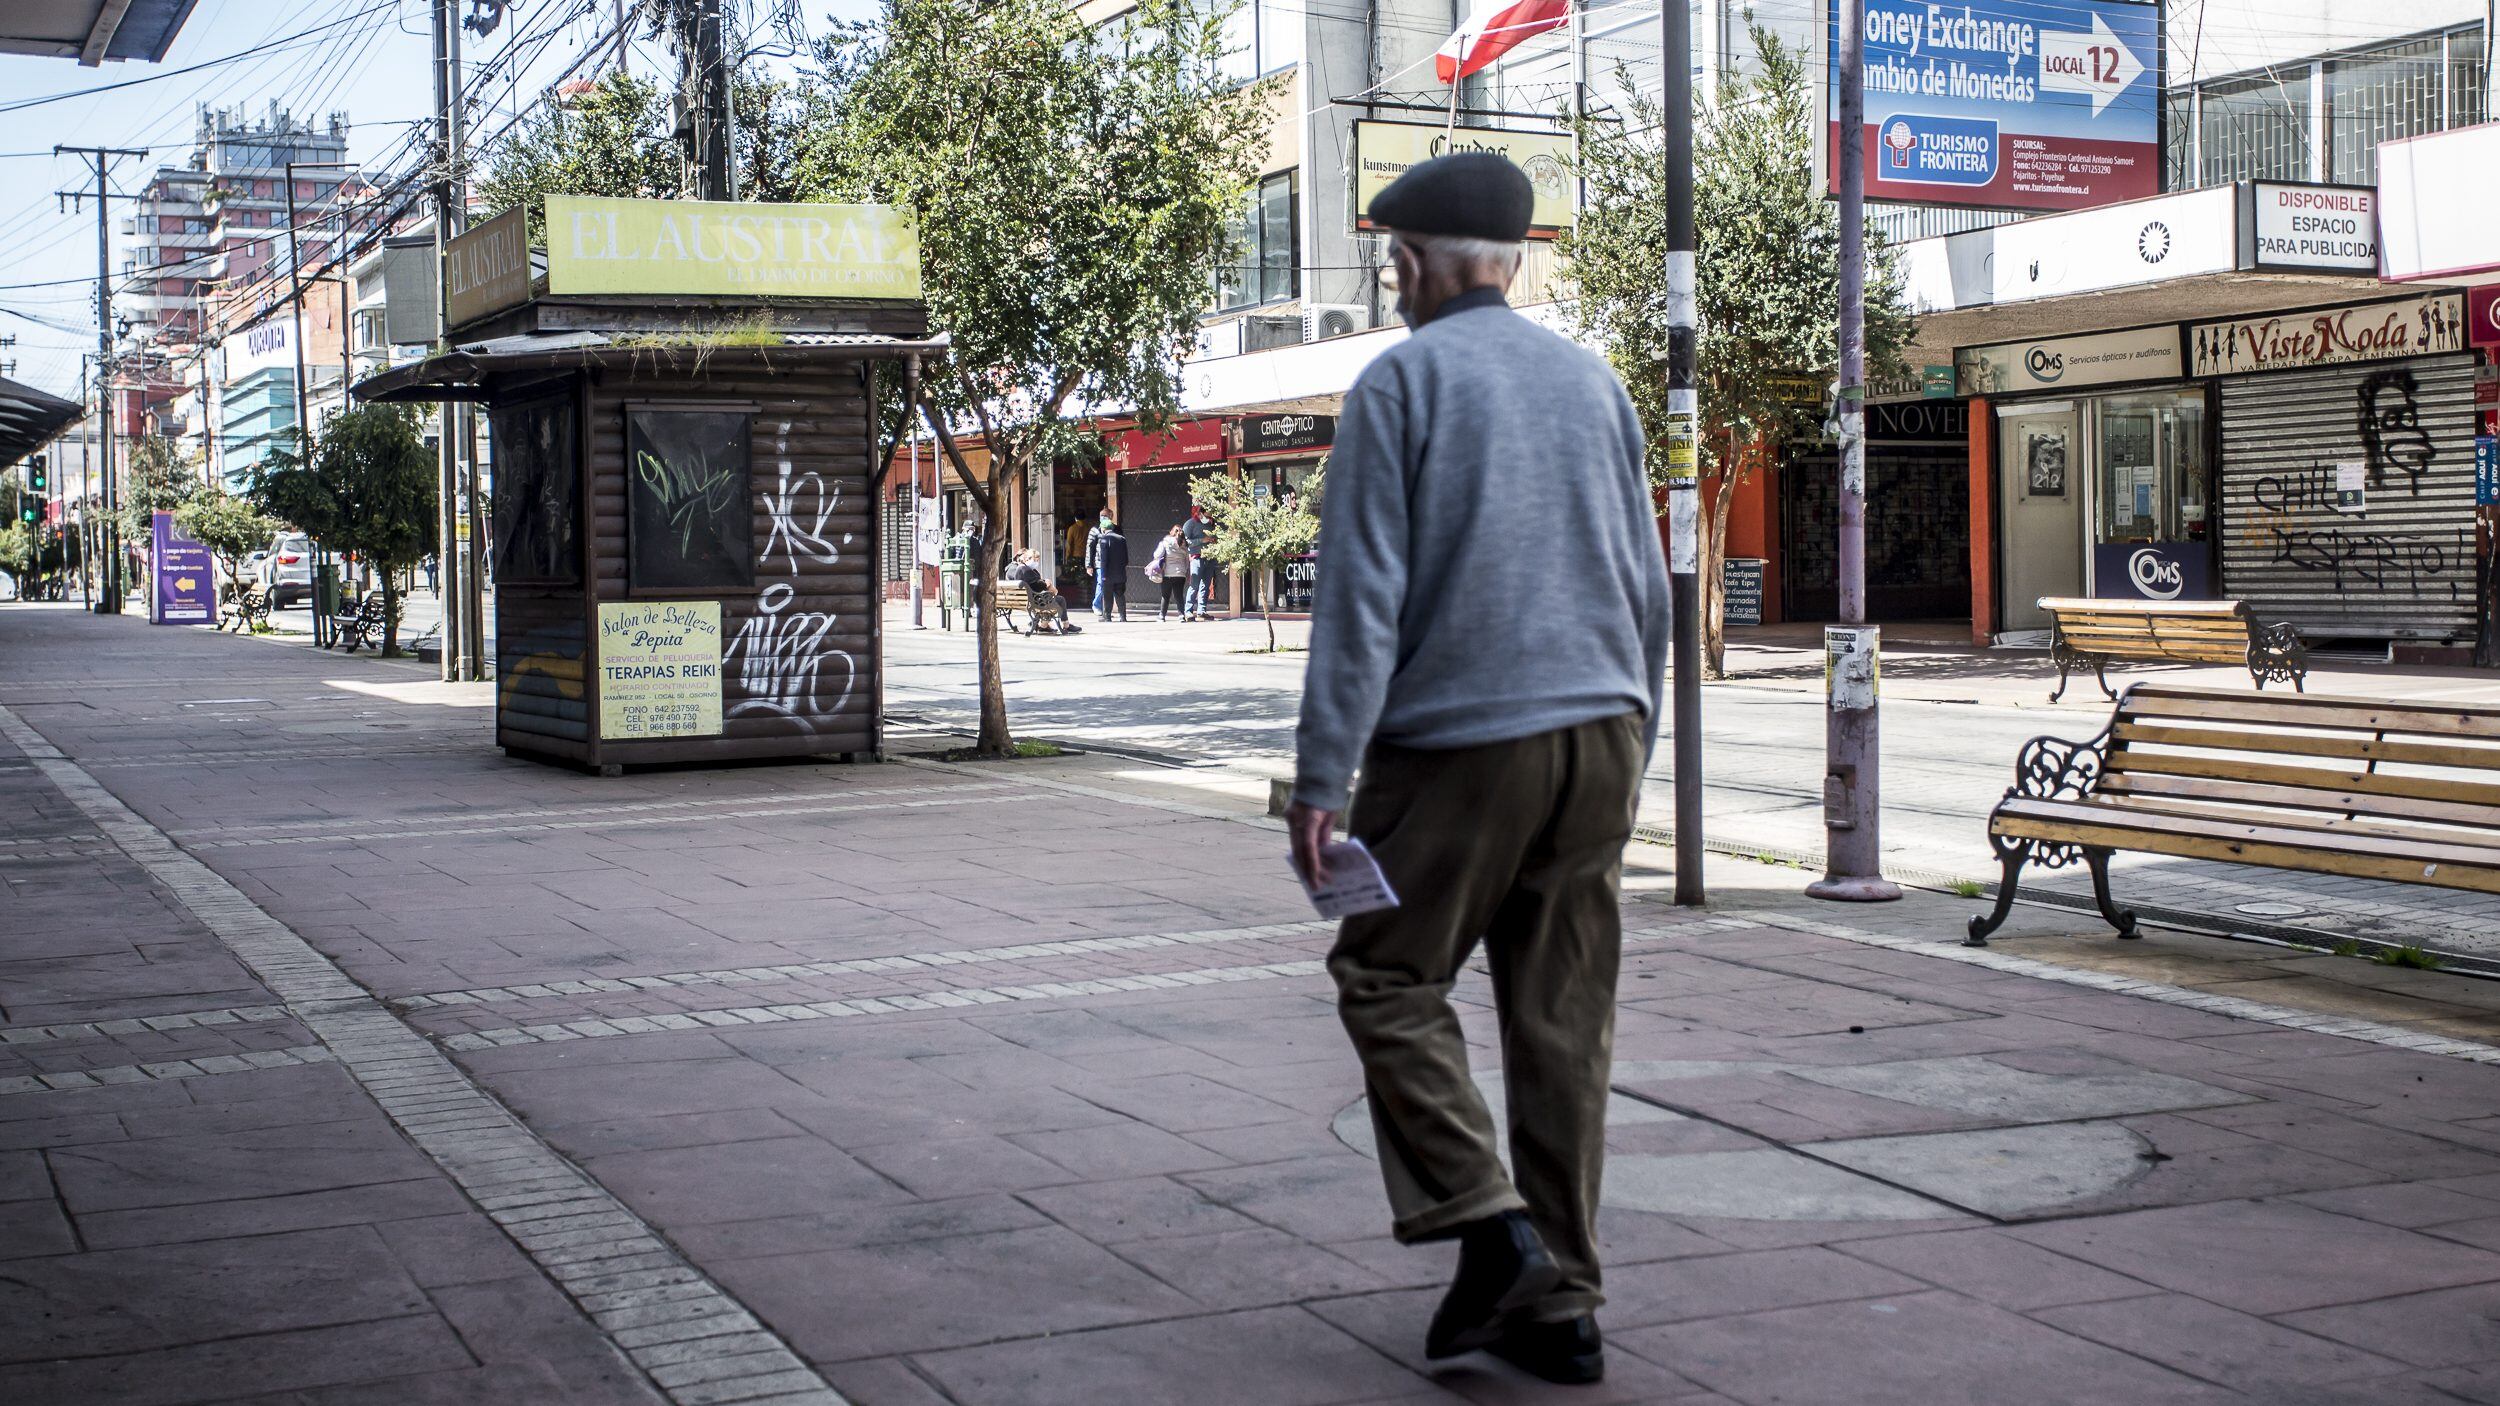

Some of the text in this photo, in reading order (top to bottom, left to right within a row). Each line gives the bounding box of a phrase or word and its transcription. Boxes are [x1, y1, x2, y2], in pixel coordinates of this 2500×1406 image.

[1863, 4, 2034, 65] oney Exchange
[2045, 46, 2120, 84] LOCAL 12
[1921, 58, 1946, 96] de
[1950, 62, 2035, 103] Monedas
[1920, 133, 1989, 153] TURISMO
[2013, 140, 2046, 150] SUCURSAL:
[1919, 151, 1989, 172] FRONTERA
[2013, 150, 2135, 166] Complejo Fronterizo Cardenal Antonio Samoré
[2013, 161, 2031, 170] Fono:
[2013, 171, 2037, 181] Pajaritos
[2041, 172, 2065, 182] Puyehue
[2013, 182, 2089, 195] www.turismofrontera.cl
[2279, 191, 2368, 213] DISPONIBLE
[2292, 216, 2356, 234] ESPACIO
[571, 210, 903, 265] EL AUSTRAL
[2257, 237, 2378, 259] PARA PUBLICIDA
[451, 248, 467, 296] EL
[467, 223, 523, 291] AUSTRAL
[809, 268, 832, 284] DE
[834, 268, 905, 284] OSORNO
[2069, 347, 2171, 366] Servicios ópticos y audífonos
[2240, 347, 2418, 373] VARIEDAD EN ROPA FEMENINA
[2034, 473, 2061, 489] 212
[1285, 562, 1316, 582] CENTR
[1741, 579, 1755, 588] tipo
[1286, 587, 1315, 598] ALEJAN
[602, 606, 717, 637] Salon de Belleza
[605, 653, 714, 664] SERVICIO DE PELUQUERIA
[606, 664, 716, 680] TERAPIAS REIKI
[609, 681, 709, 692] HORARIO CONTINUADO
[623, 704, 700, 715] FONO 642 237592
[649, 714, 664, 722] 976
[649, 723, 664, 731] 966
